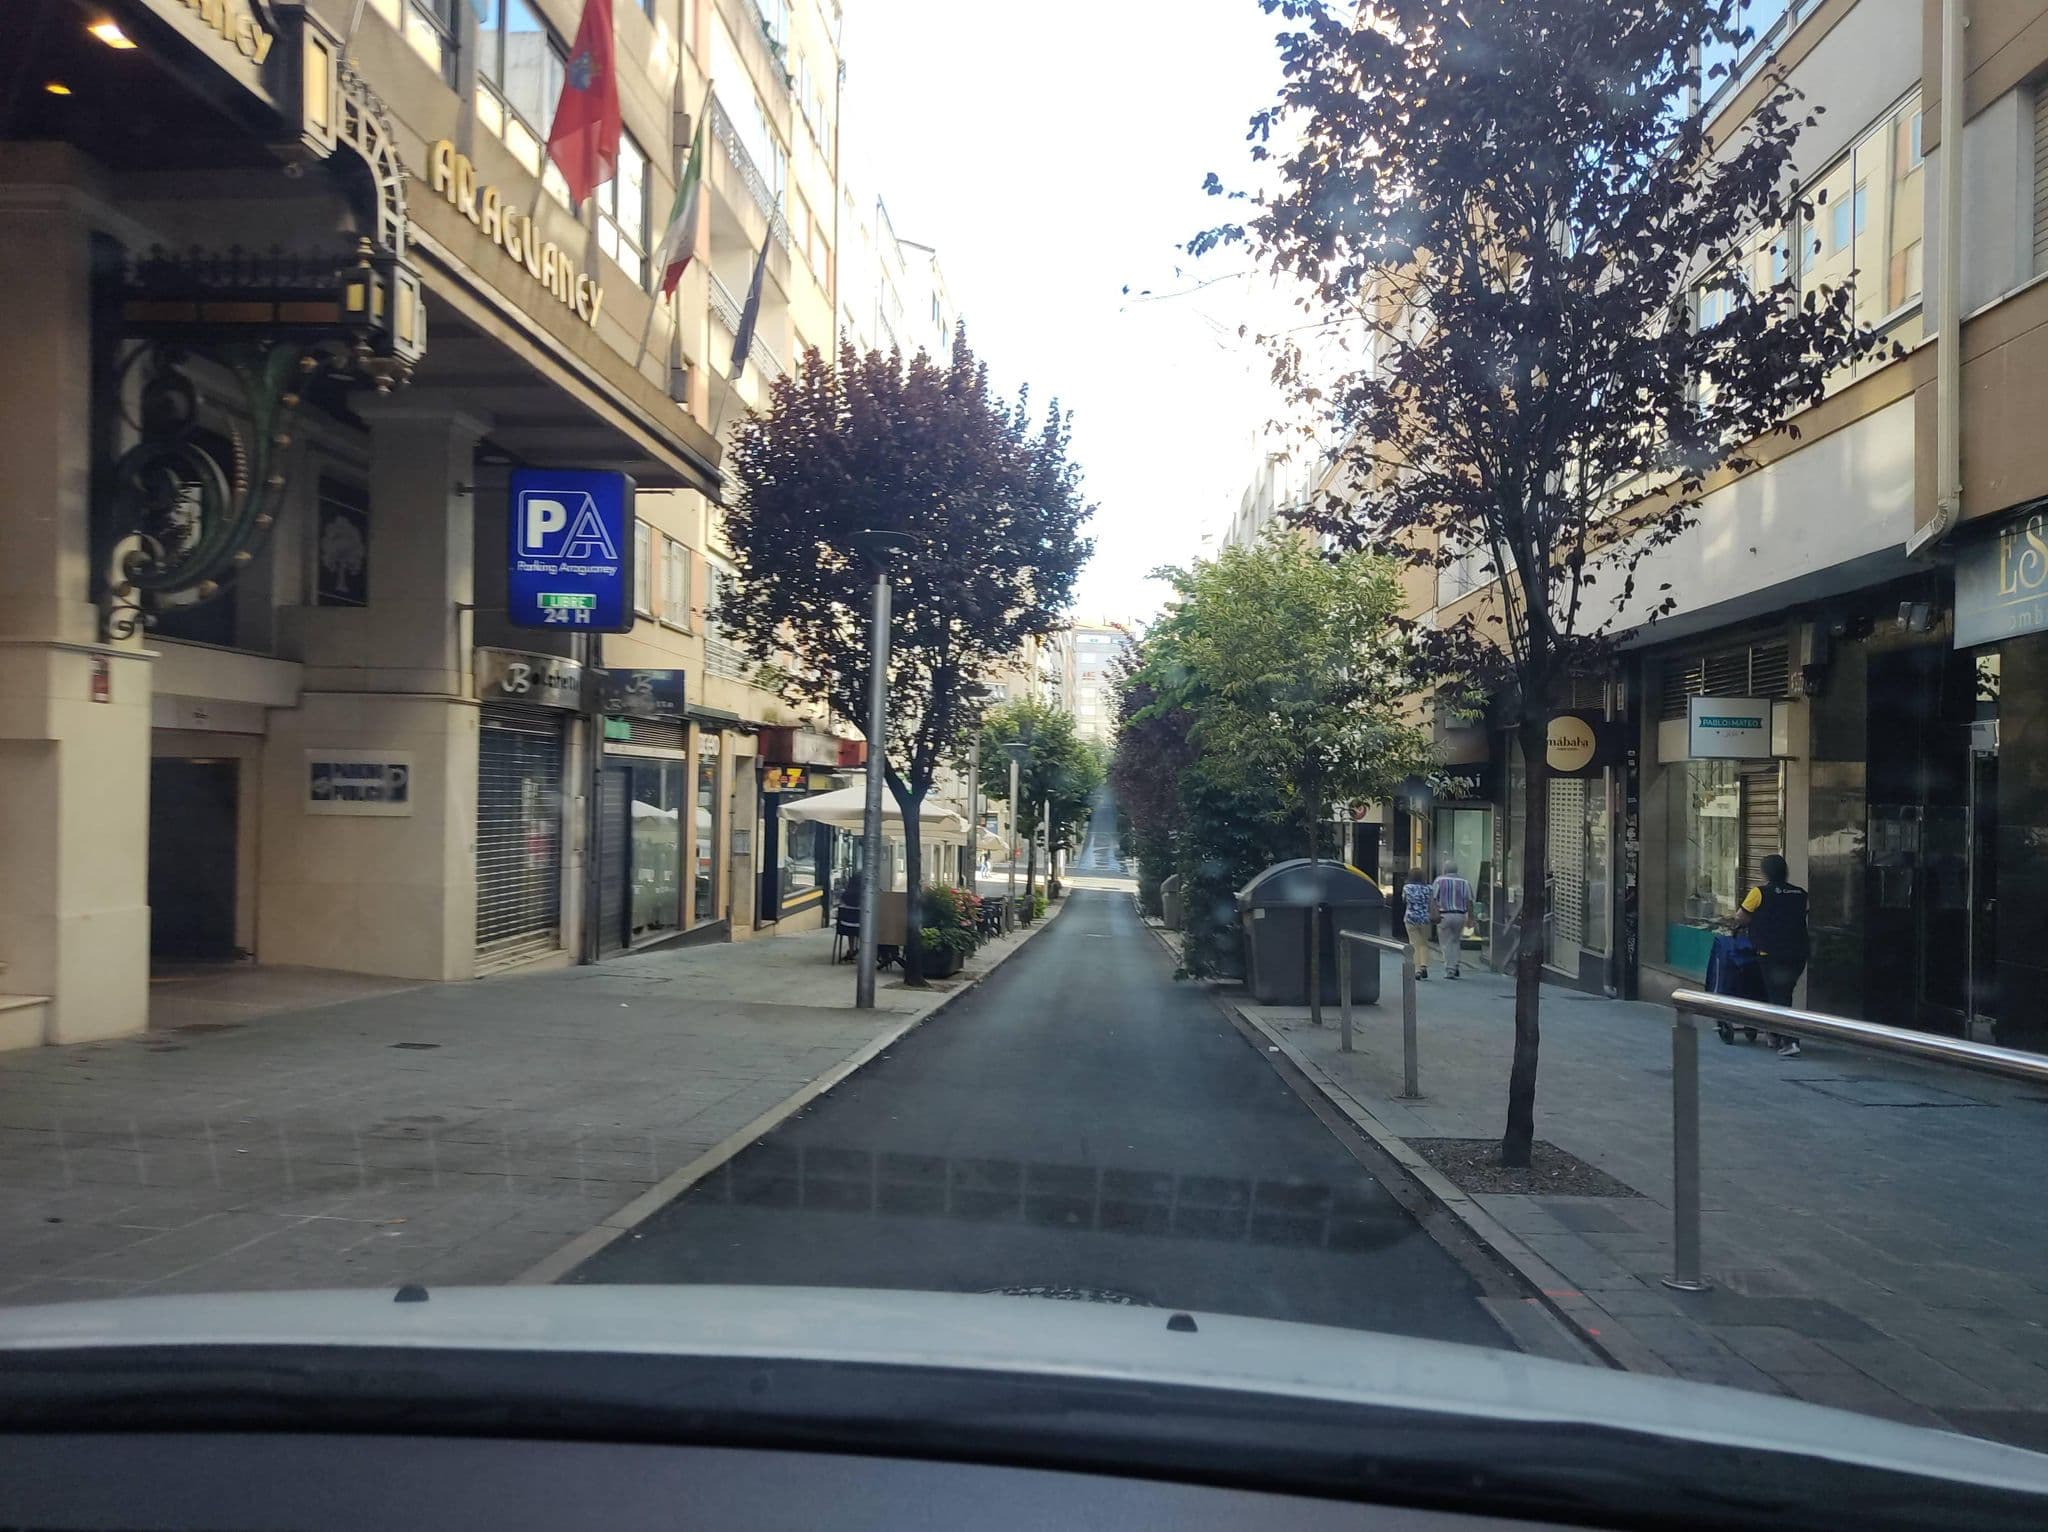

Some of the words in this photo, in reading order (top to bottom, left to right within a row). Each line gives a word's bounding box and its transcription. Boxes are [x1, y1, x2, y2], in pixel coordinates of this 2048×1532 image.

[433, 140, 604, 328] ARAGUANEY
[550, 596, 587, 607] LIBRE
[544, 609, 569, 623] 24
[574, 610, 591, 623] H
